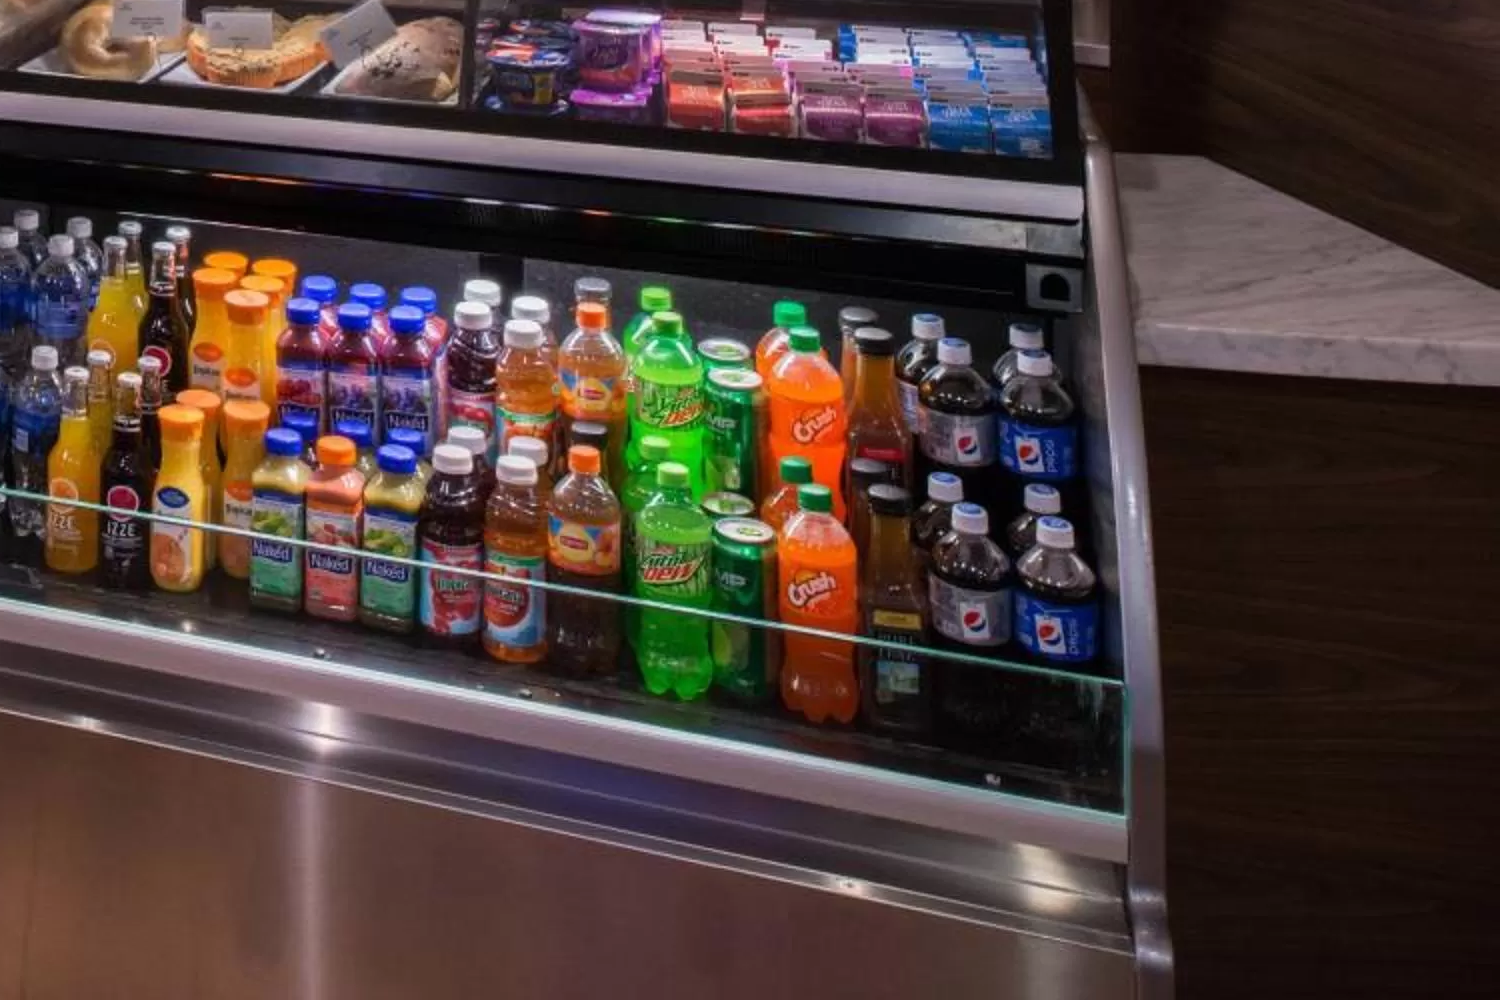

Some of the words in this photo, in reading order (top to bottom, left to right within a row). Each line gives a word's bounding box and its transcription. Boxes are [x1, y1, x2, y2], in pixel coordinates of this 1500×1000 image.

[793, 406, 836, 442] Crush
[106, 521, 136, 537] IZZE
[253, 540, 290, 561] Naked
[311, 553, 350, 572] Naked
[367, 560, 406, 580] Naked
[788, 571, 836, 607] Crush
